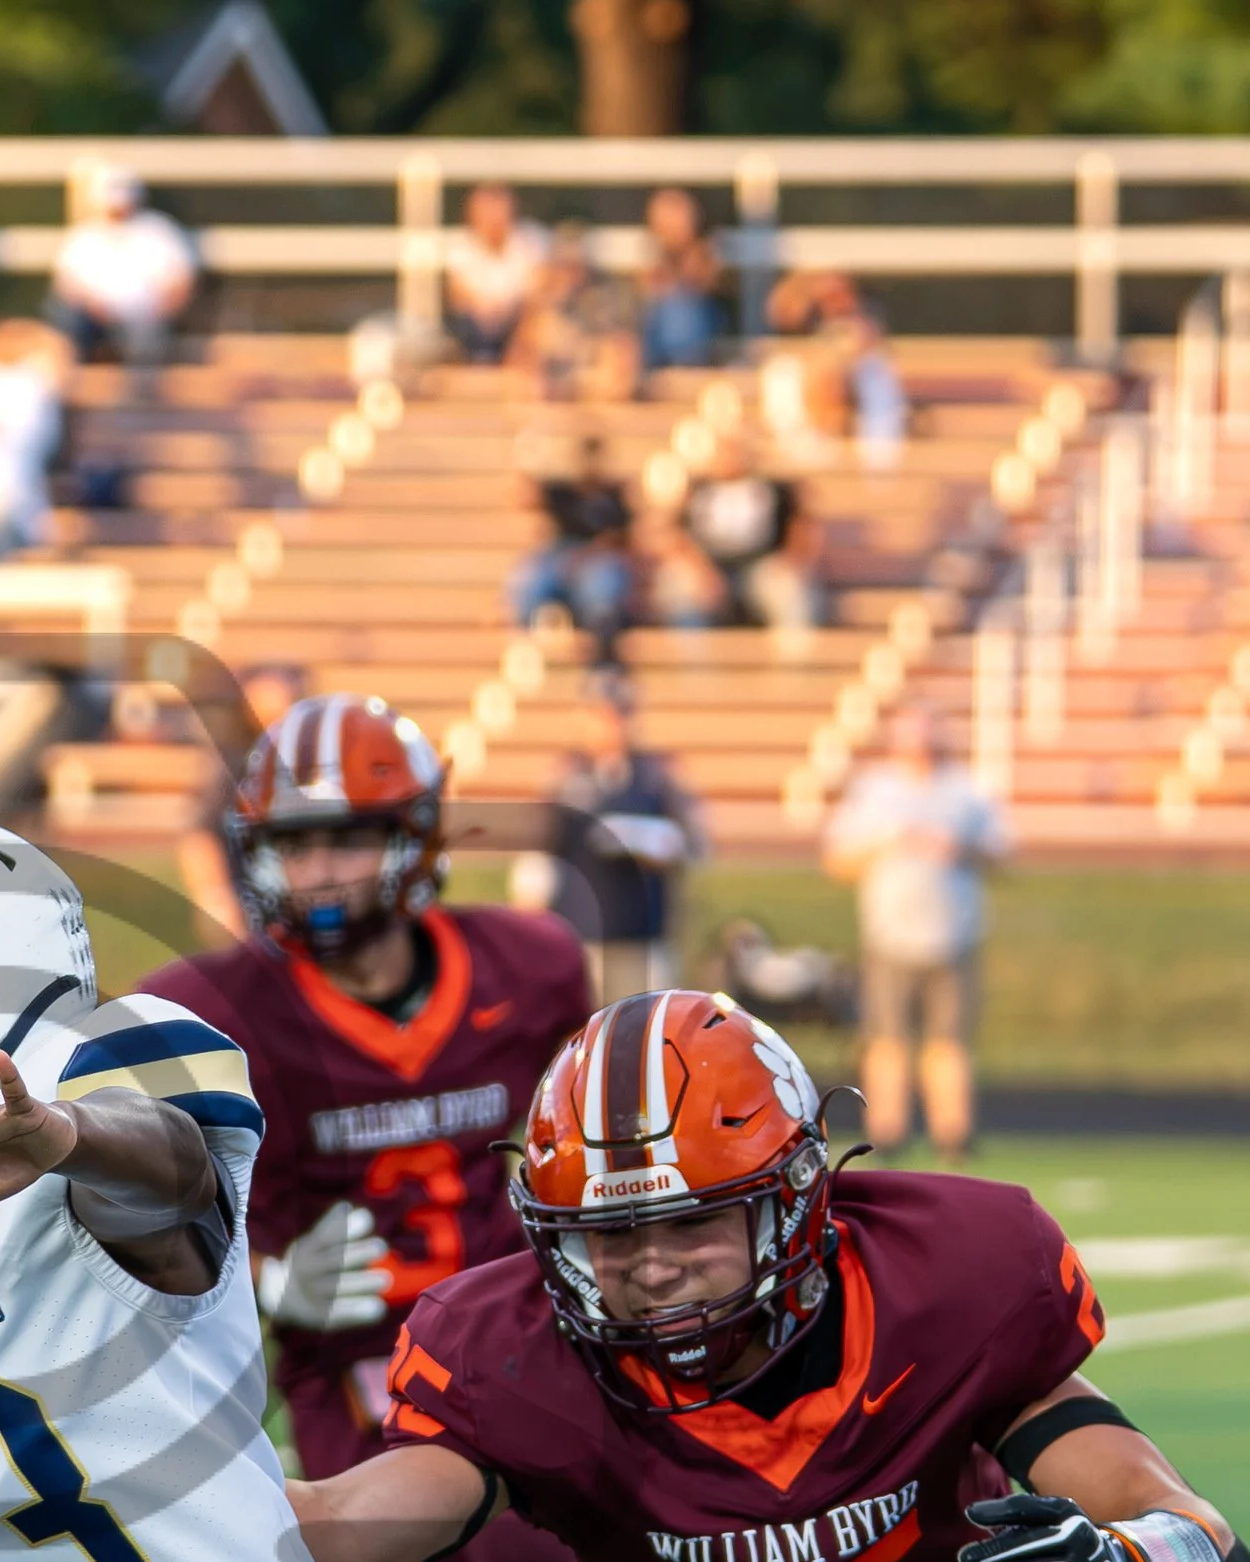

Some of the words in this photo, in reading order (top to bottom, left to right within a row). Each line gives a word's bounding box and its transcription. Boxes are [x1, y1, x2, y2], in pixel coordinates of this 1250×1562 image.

[593, 1174, 671, 1199] Riddell
[364, 1138, 467, 1307] 3
[765, 1195, 807, 1262] Rddell
[550, 1247, 602, 1307] Riddell
[826, 1479, 919, 1557] BYRD
